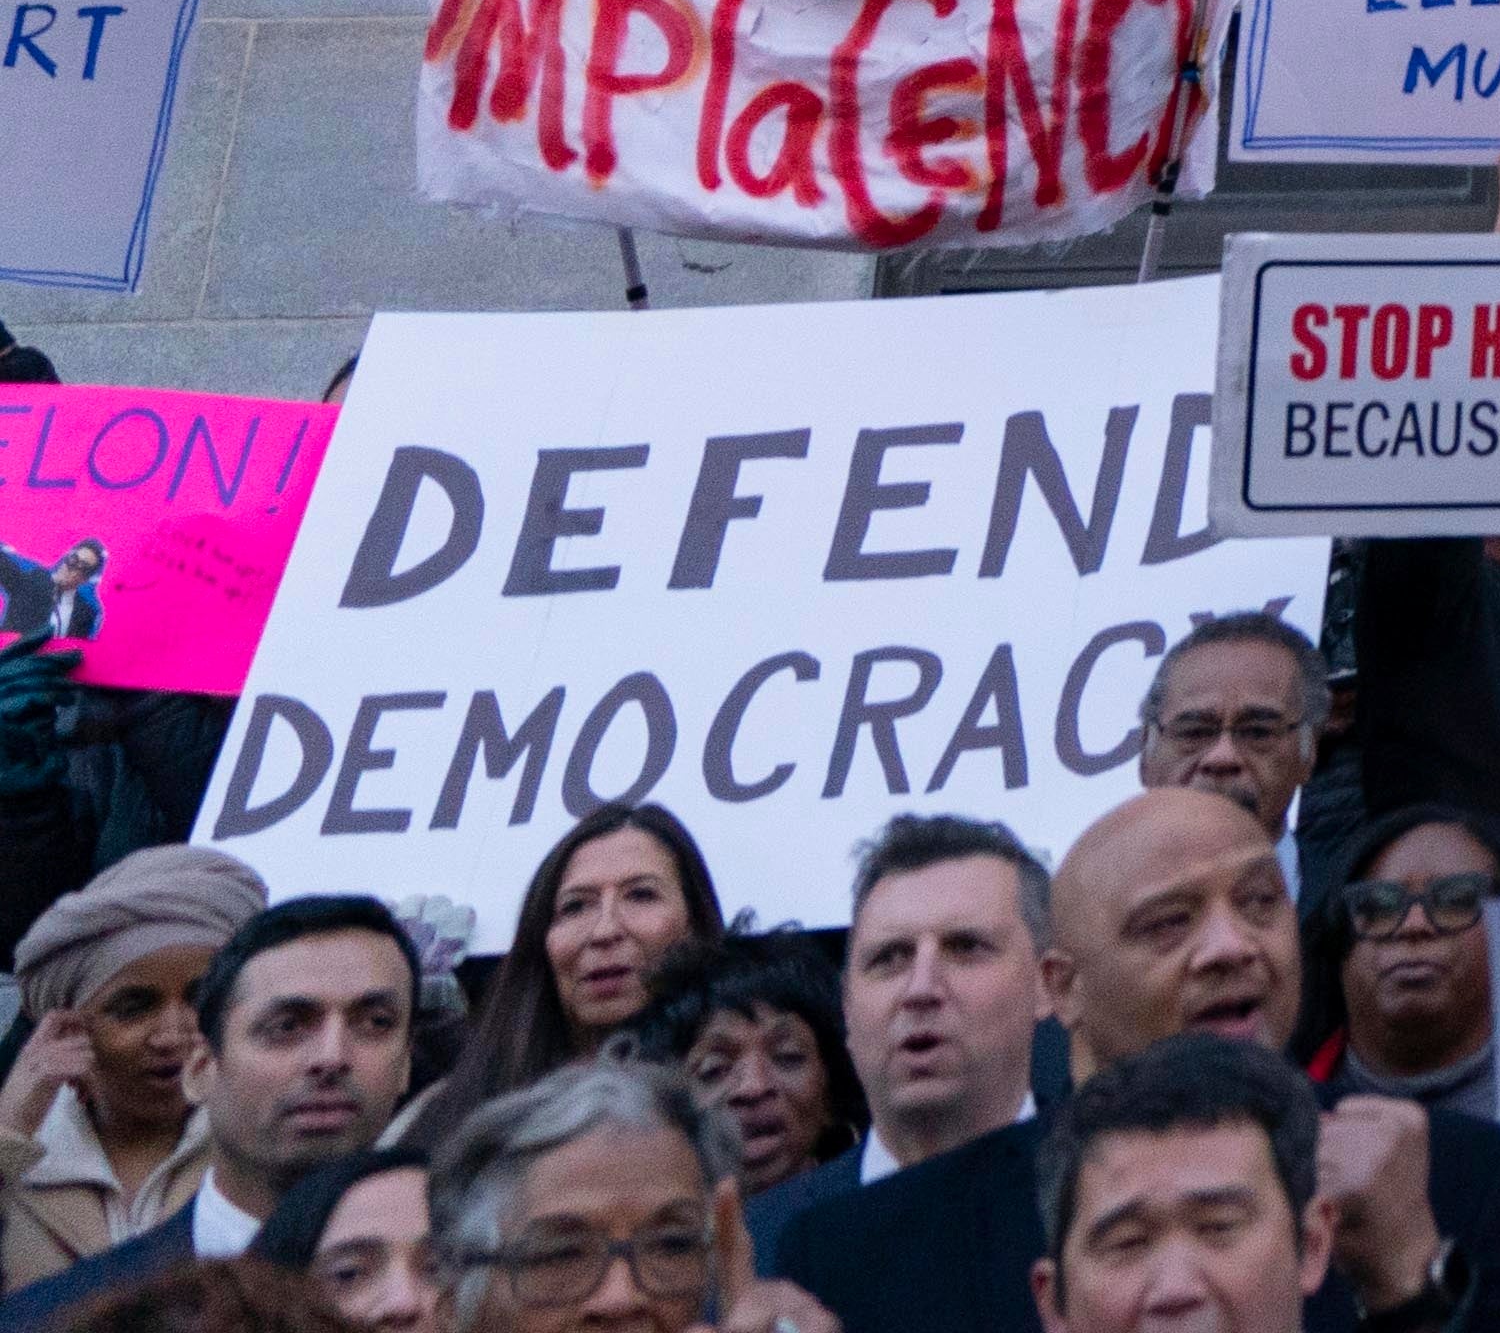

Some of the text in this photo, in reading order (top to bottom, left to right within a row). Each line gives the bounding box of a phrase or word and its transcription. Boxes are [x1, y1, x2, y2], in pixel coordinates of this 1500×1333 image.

[2, 1, 128, 81] RT
[1288, 303, 1452, 382] STOP
[210, 595, 1296, 841] DEMOCRAC
